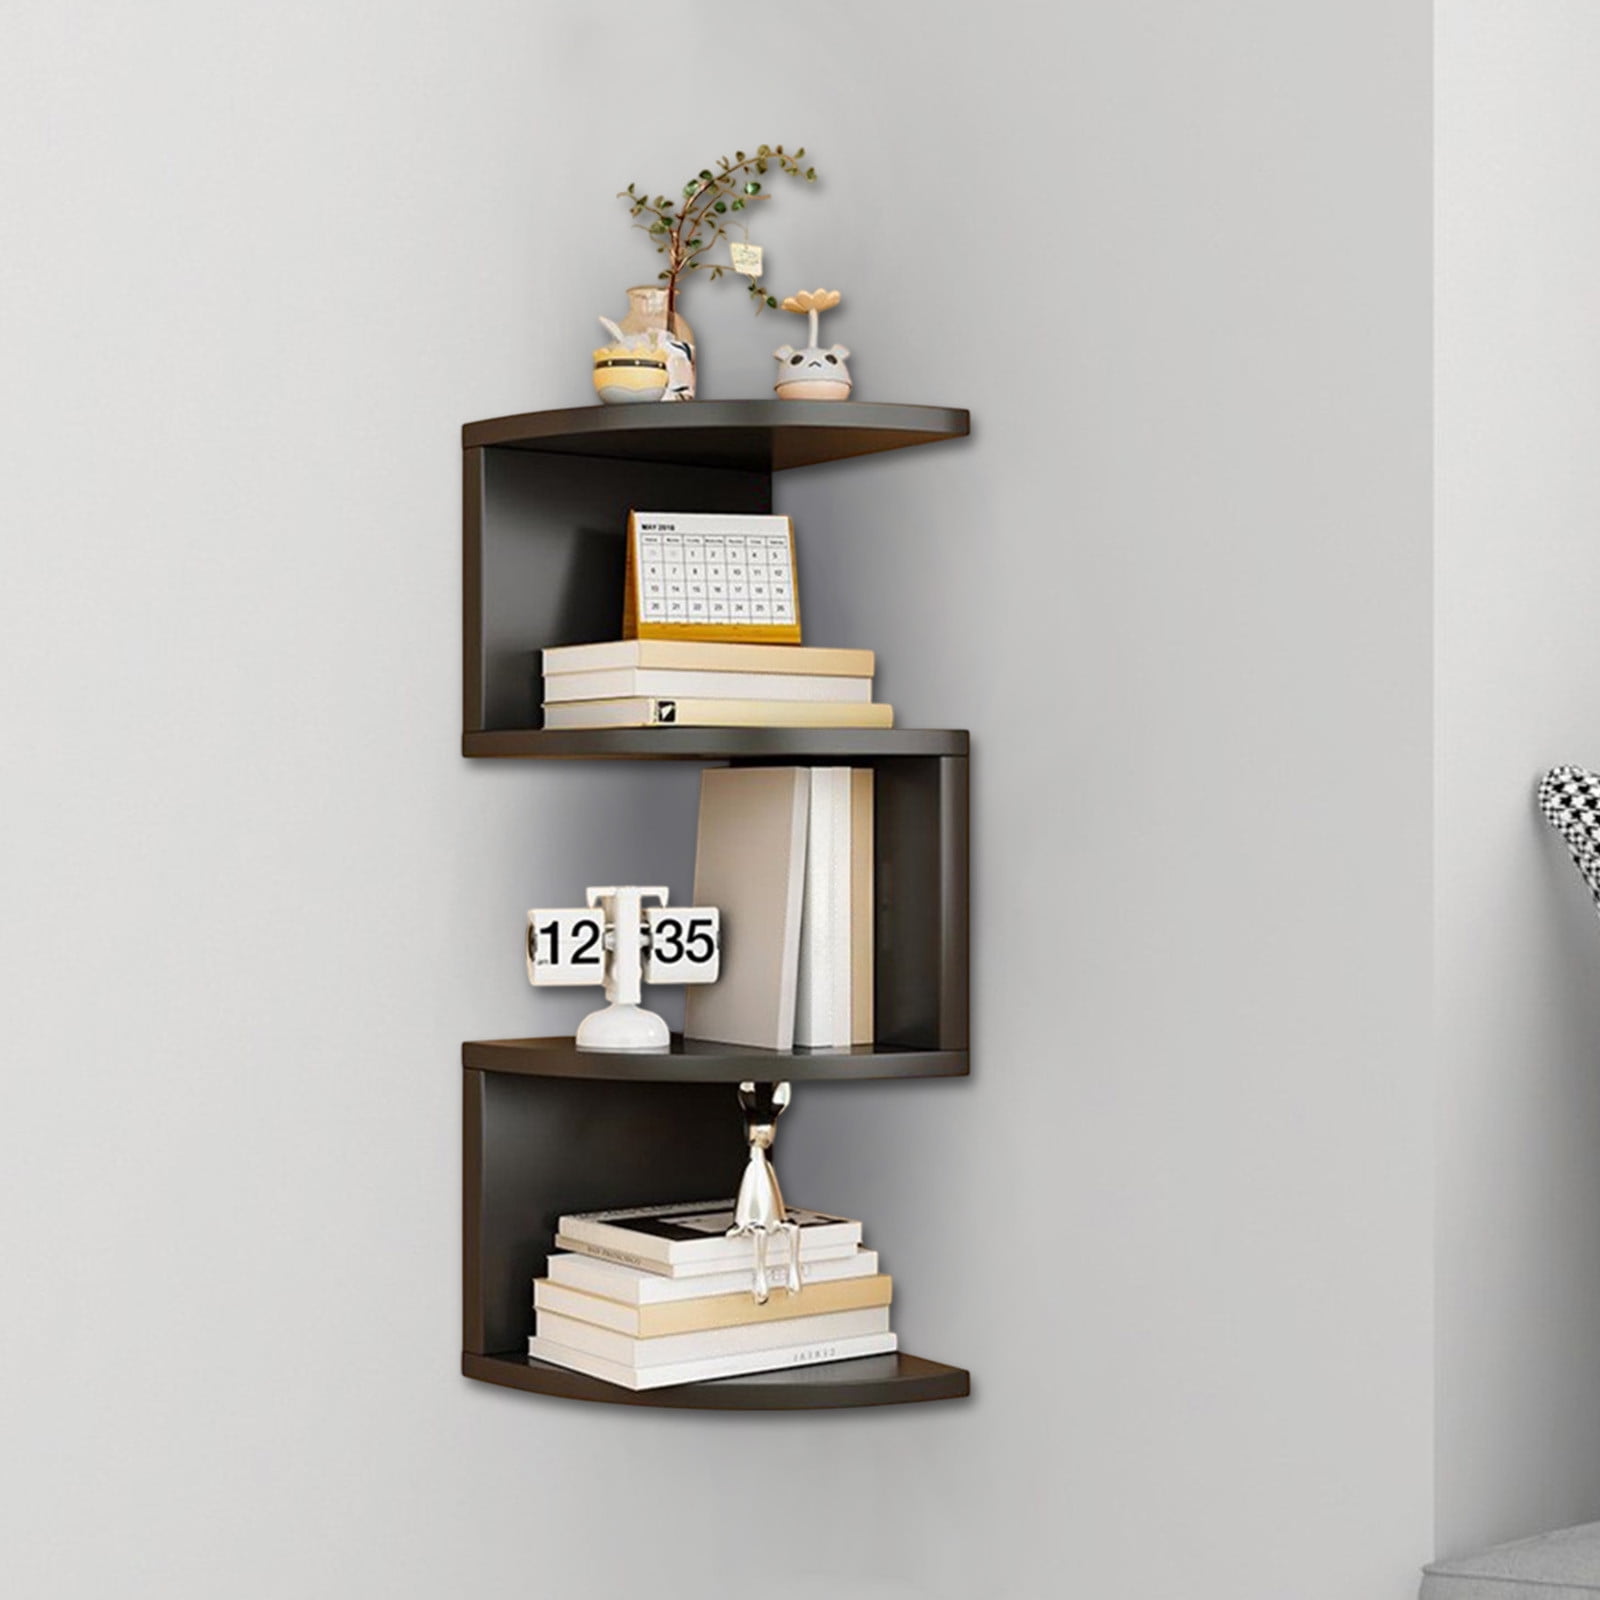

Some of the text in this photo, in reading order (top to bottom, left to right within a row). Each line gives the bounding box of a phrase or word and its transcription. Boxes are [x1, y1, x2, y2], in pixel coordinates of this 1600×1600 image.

[641, 523, 657, 531] MAY
[732, 568, 742, 576] 10
[752, 568, 762, 577] 11
[773, 569, 783, 577] 12
[650, 584, 785, 595] 13 14 15 16 17 18 19
[651, 602, 786, 612] 20 21 22 23 24 25 26
[539, 918, 715, 965] 12 35
